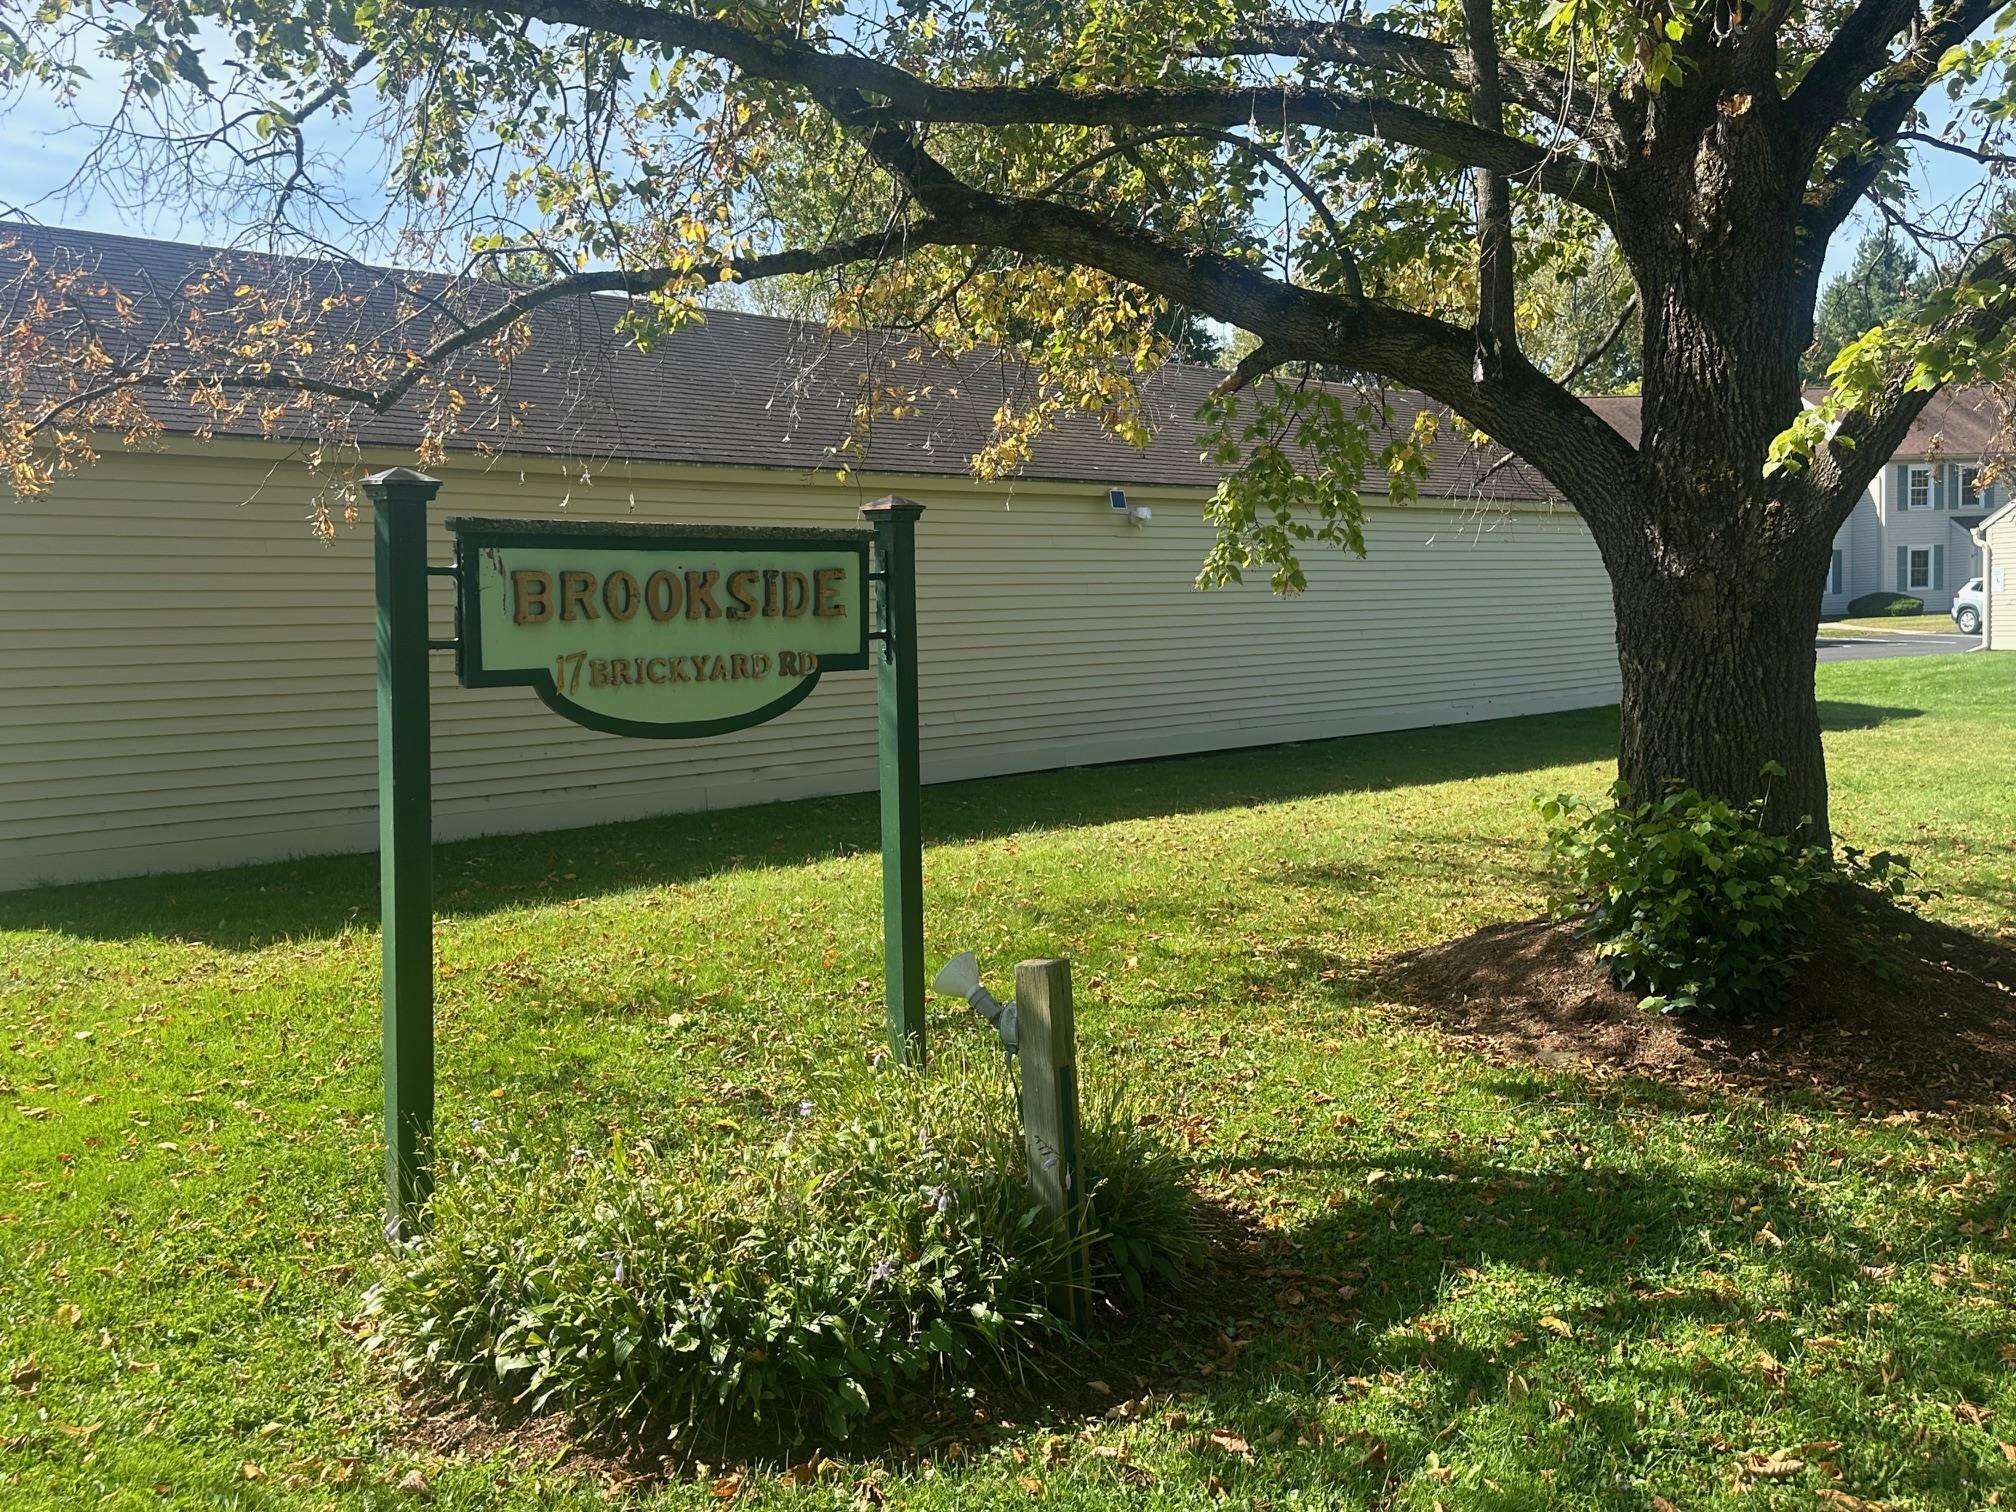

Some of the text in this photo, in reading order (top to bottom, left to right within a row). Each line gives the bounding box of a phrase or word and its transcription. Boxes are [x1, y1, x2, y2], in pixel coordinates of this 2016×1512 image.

[511, 568, 847, 625] BROOKSIDE
[555, 651, 818, 696] 17 BRICKYARD RD
